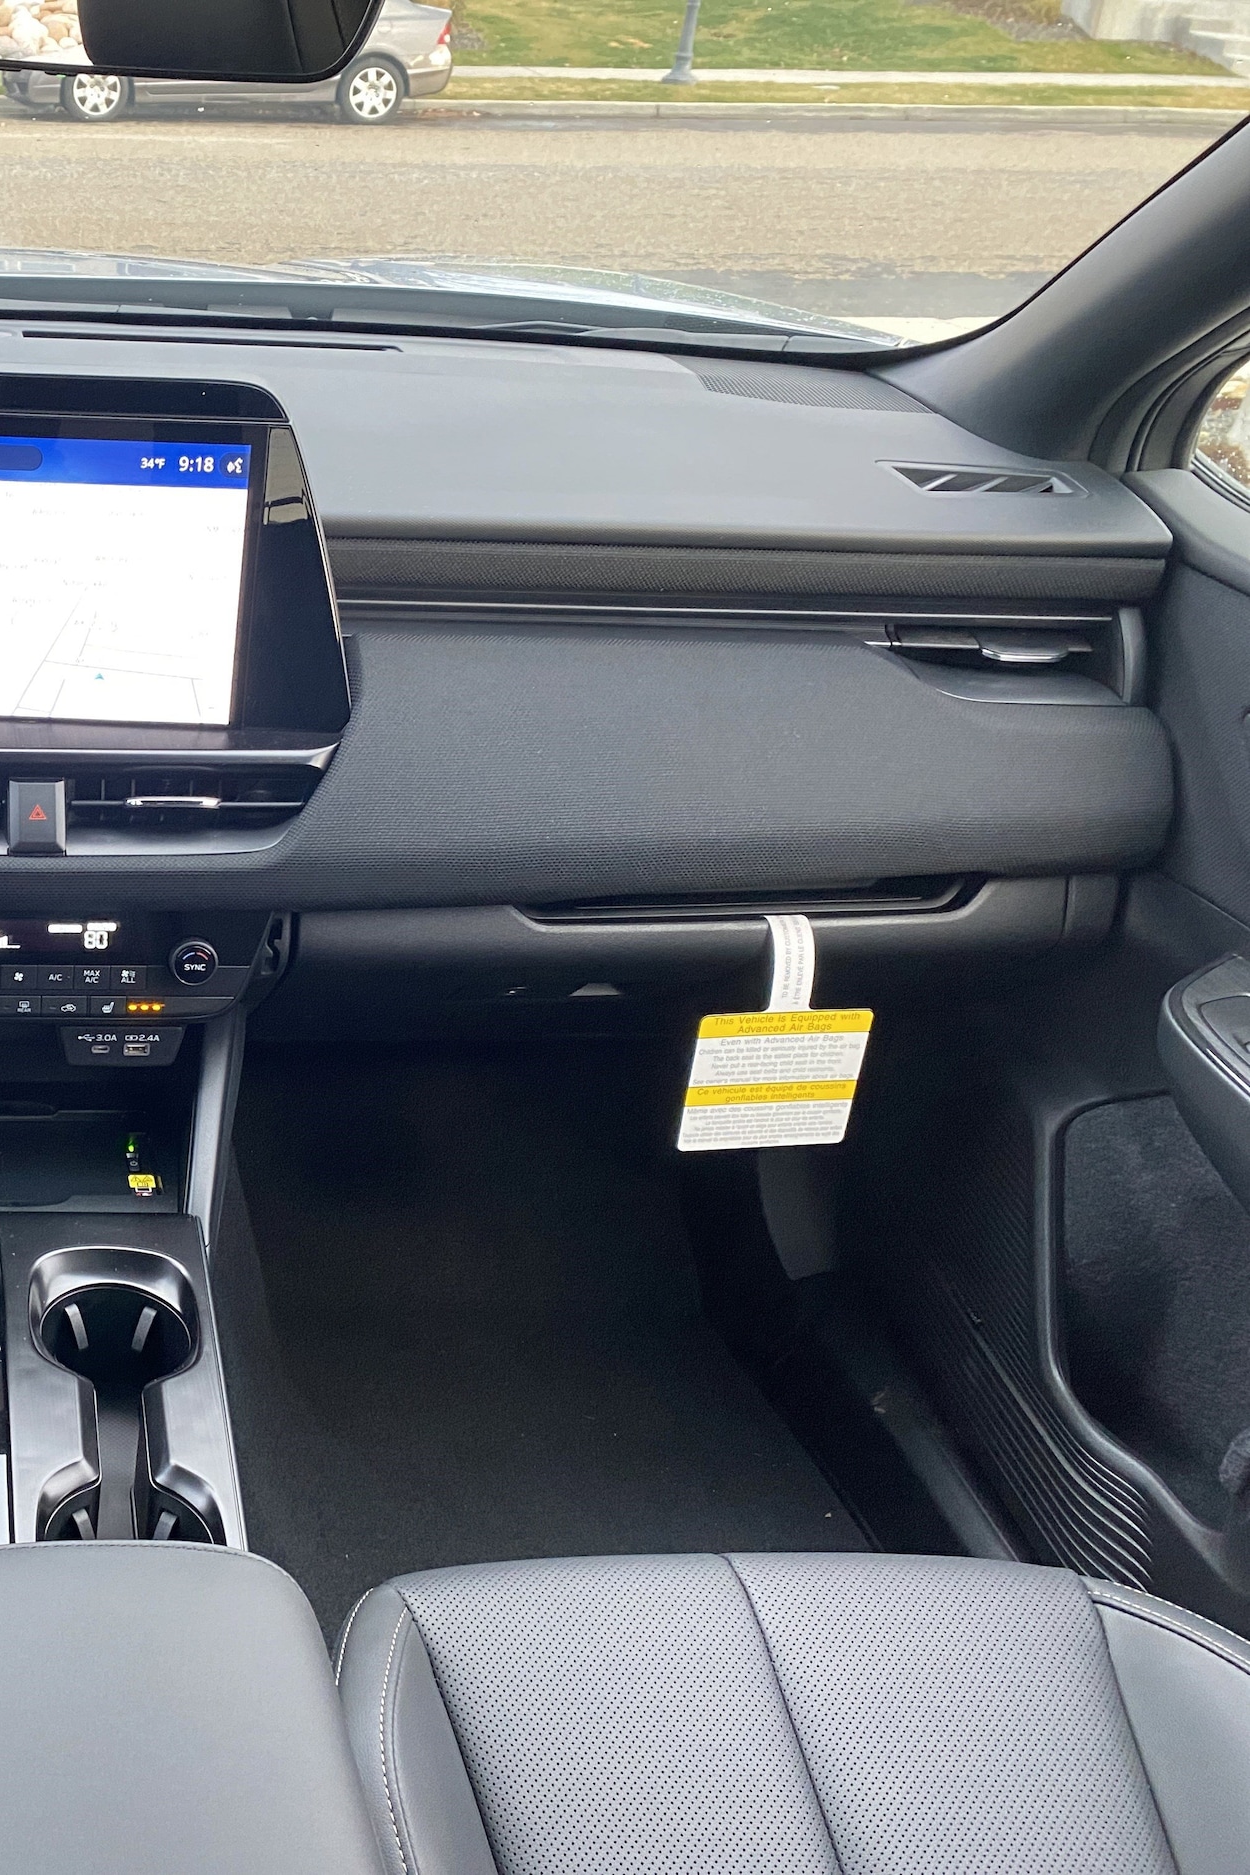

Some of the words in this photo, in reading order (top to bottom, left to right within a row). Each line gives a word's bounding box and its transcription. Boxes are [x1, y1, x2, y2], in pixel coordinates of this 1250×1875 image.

[178, 456, 215, 473] 9:18
[84, 930, 109, 949] 80
[184, 963, 207, 971] SYNC
[48, 973, 63, 981] A/C
[83, 969, 100, 977] MAX
[85, 976, 99, 984] A/C
[120, 976, 136, 984] ALL
[715, 1017, 734, 1026] This
[739, 1015, 774, 1024] Vehicle
[778, 1014, 786, 1022] is
[791, 1013, 837, 1024] Equipped
[841, 1012, 860, 1020] with
[737, 1023, 786, 1034] Advanced
[789, 1023, 803, 1031] Air
[807, 1022, 832, 1033] Bags
[96, 1034, 117, 1042] 3.0A
[138, 1034, 160, 1042] 2.4A
[720, 1038, 741, 1046] Even
[764, 1035, 805, 1045] Advanced
[822, 1034, 845, 1044] Bags
[711, 1086, 747, 1094] véhicule
[769, 1091, 815, 1100] intelligents
